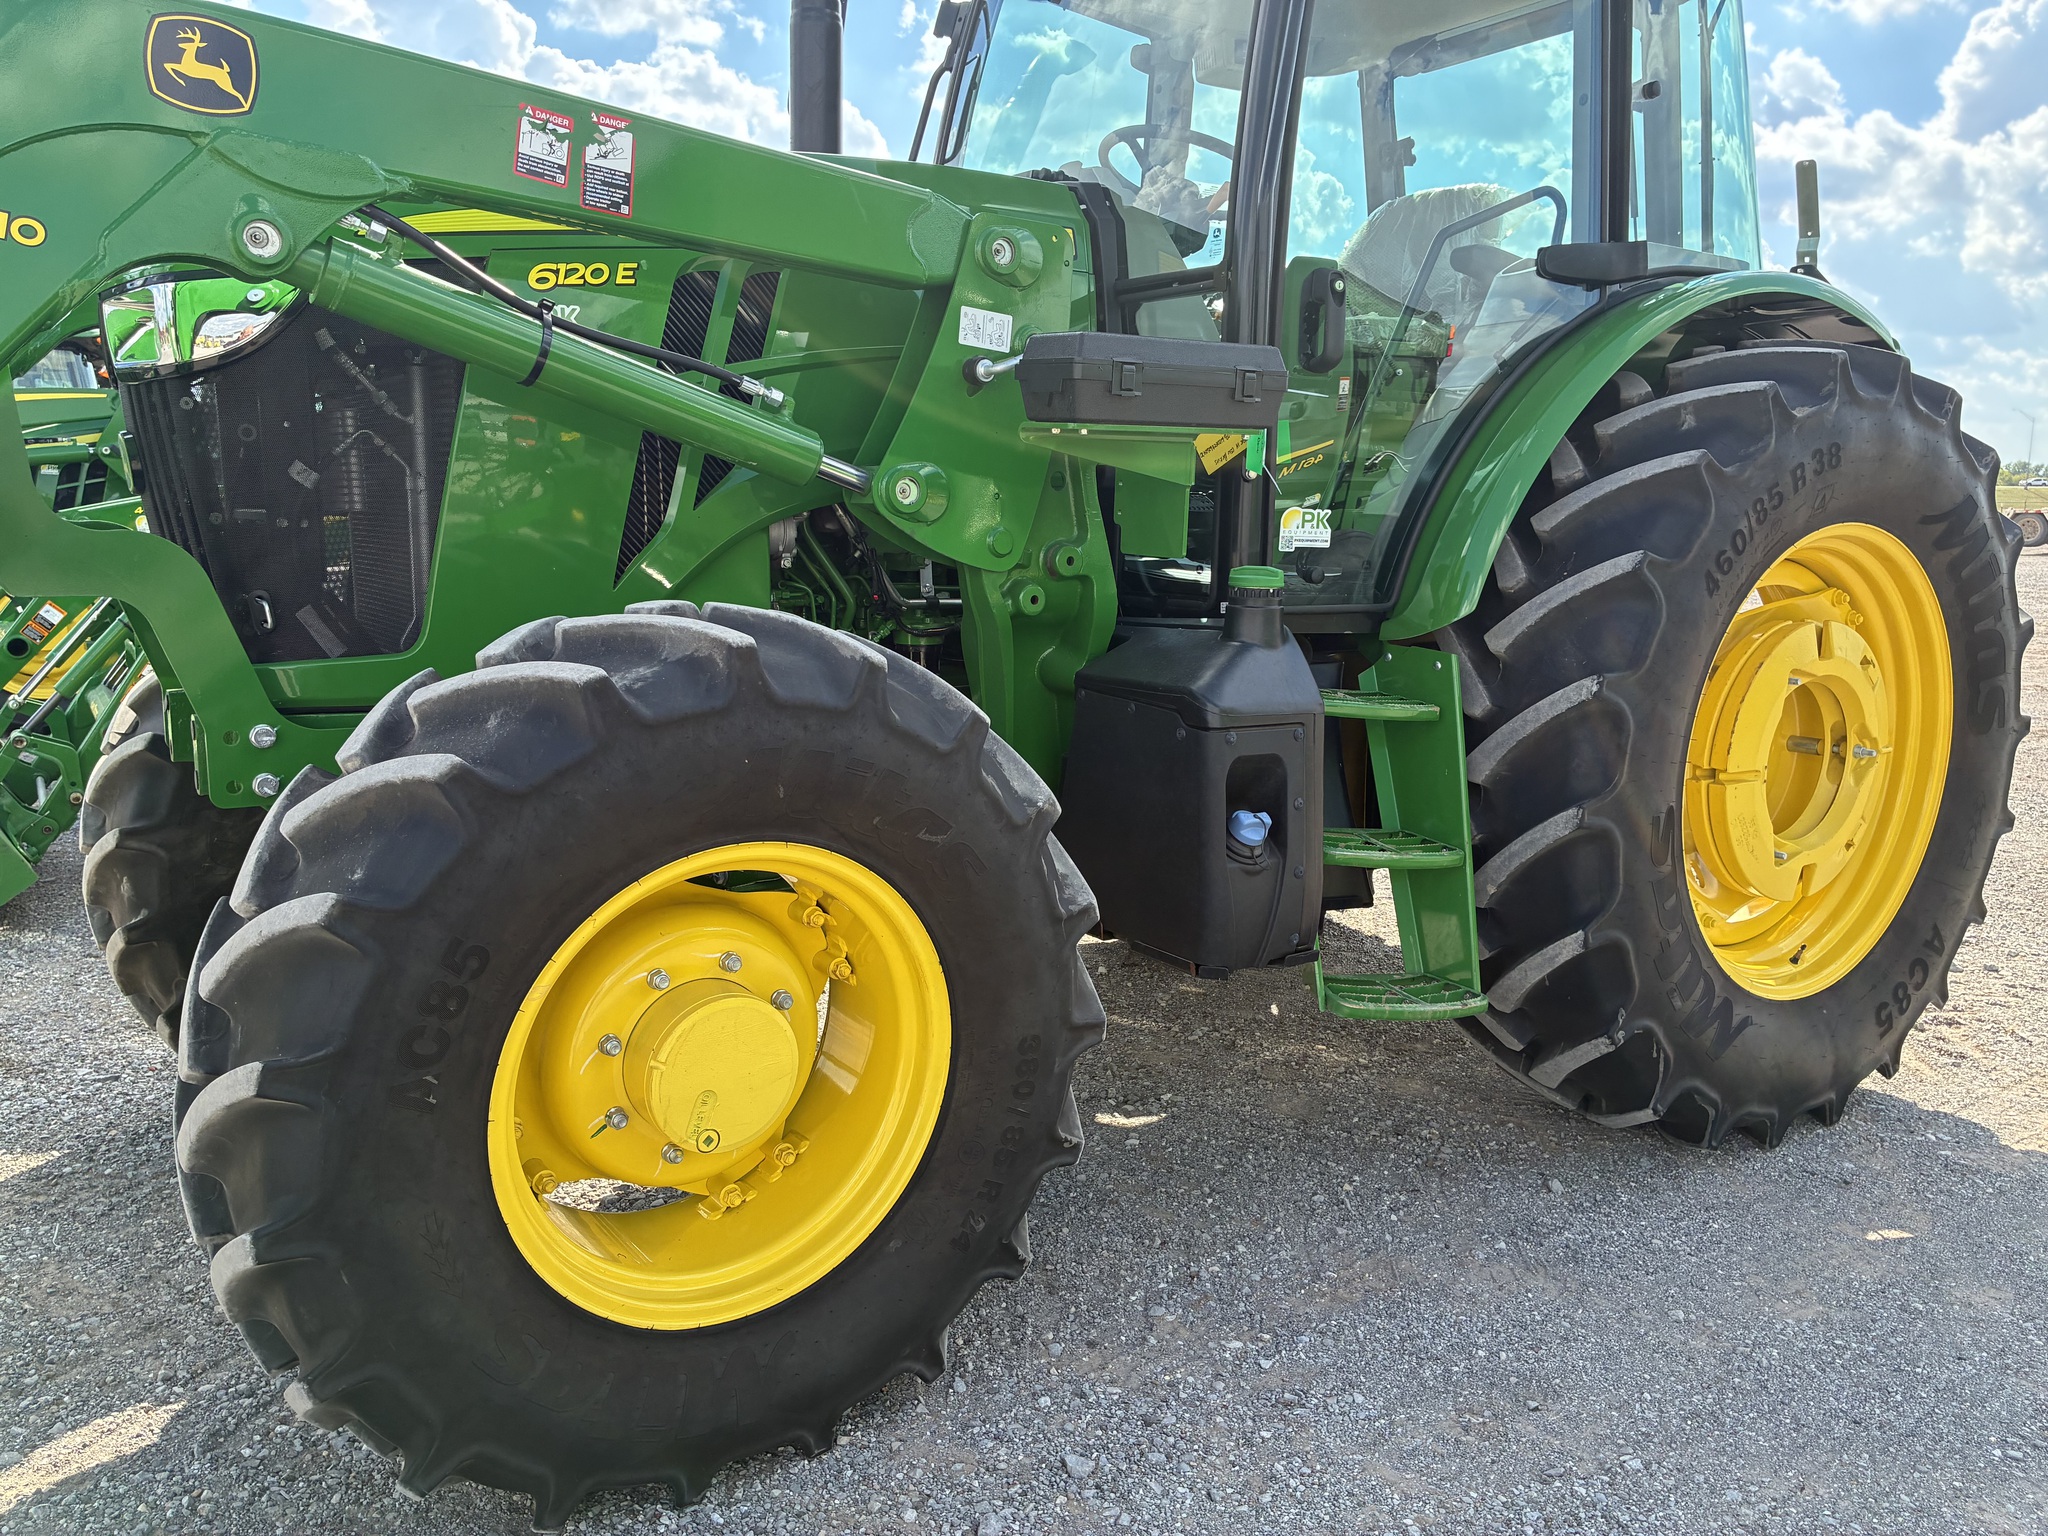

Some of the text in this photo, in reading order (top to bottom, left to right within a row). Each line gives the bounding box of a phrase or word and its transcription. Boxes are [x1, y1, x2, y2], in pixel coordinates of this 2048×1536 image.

[536, 110, 570, 127] DANGER
[600, 116, 629, 129] DANGE
[527, 262, 639, 292] 6120 E
[1301, 512, 1328, 530] P&K
[1704, 481, 1784, 599] 460/85
[1811, 441, 1842, 478] 38
[1874, 922, 1946, 1041] AC85
[386, 934, 491, 1115] AC85
